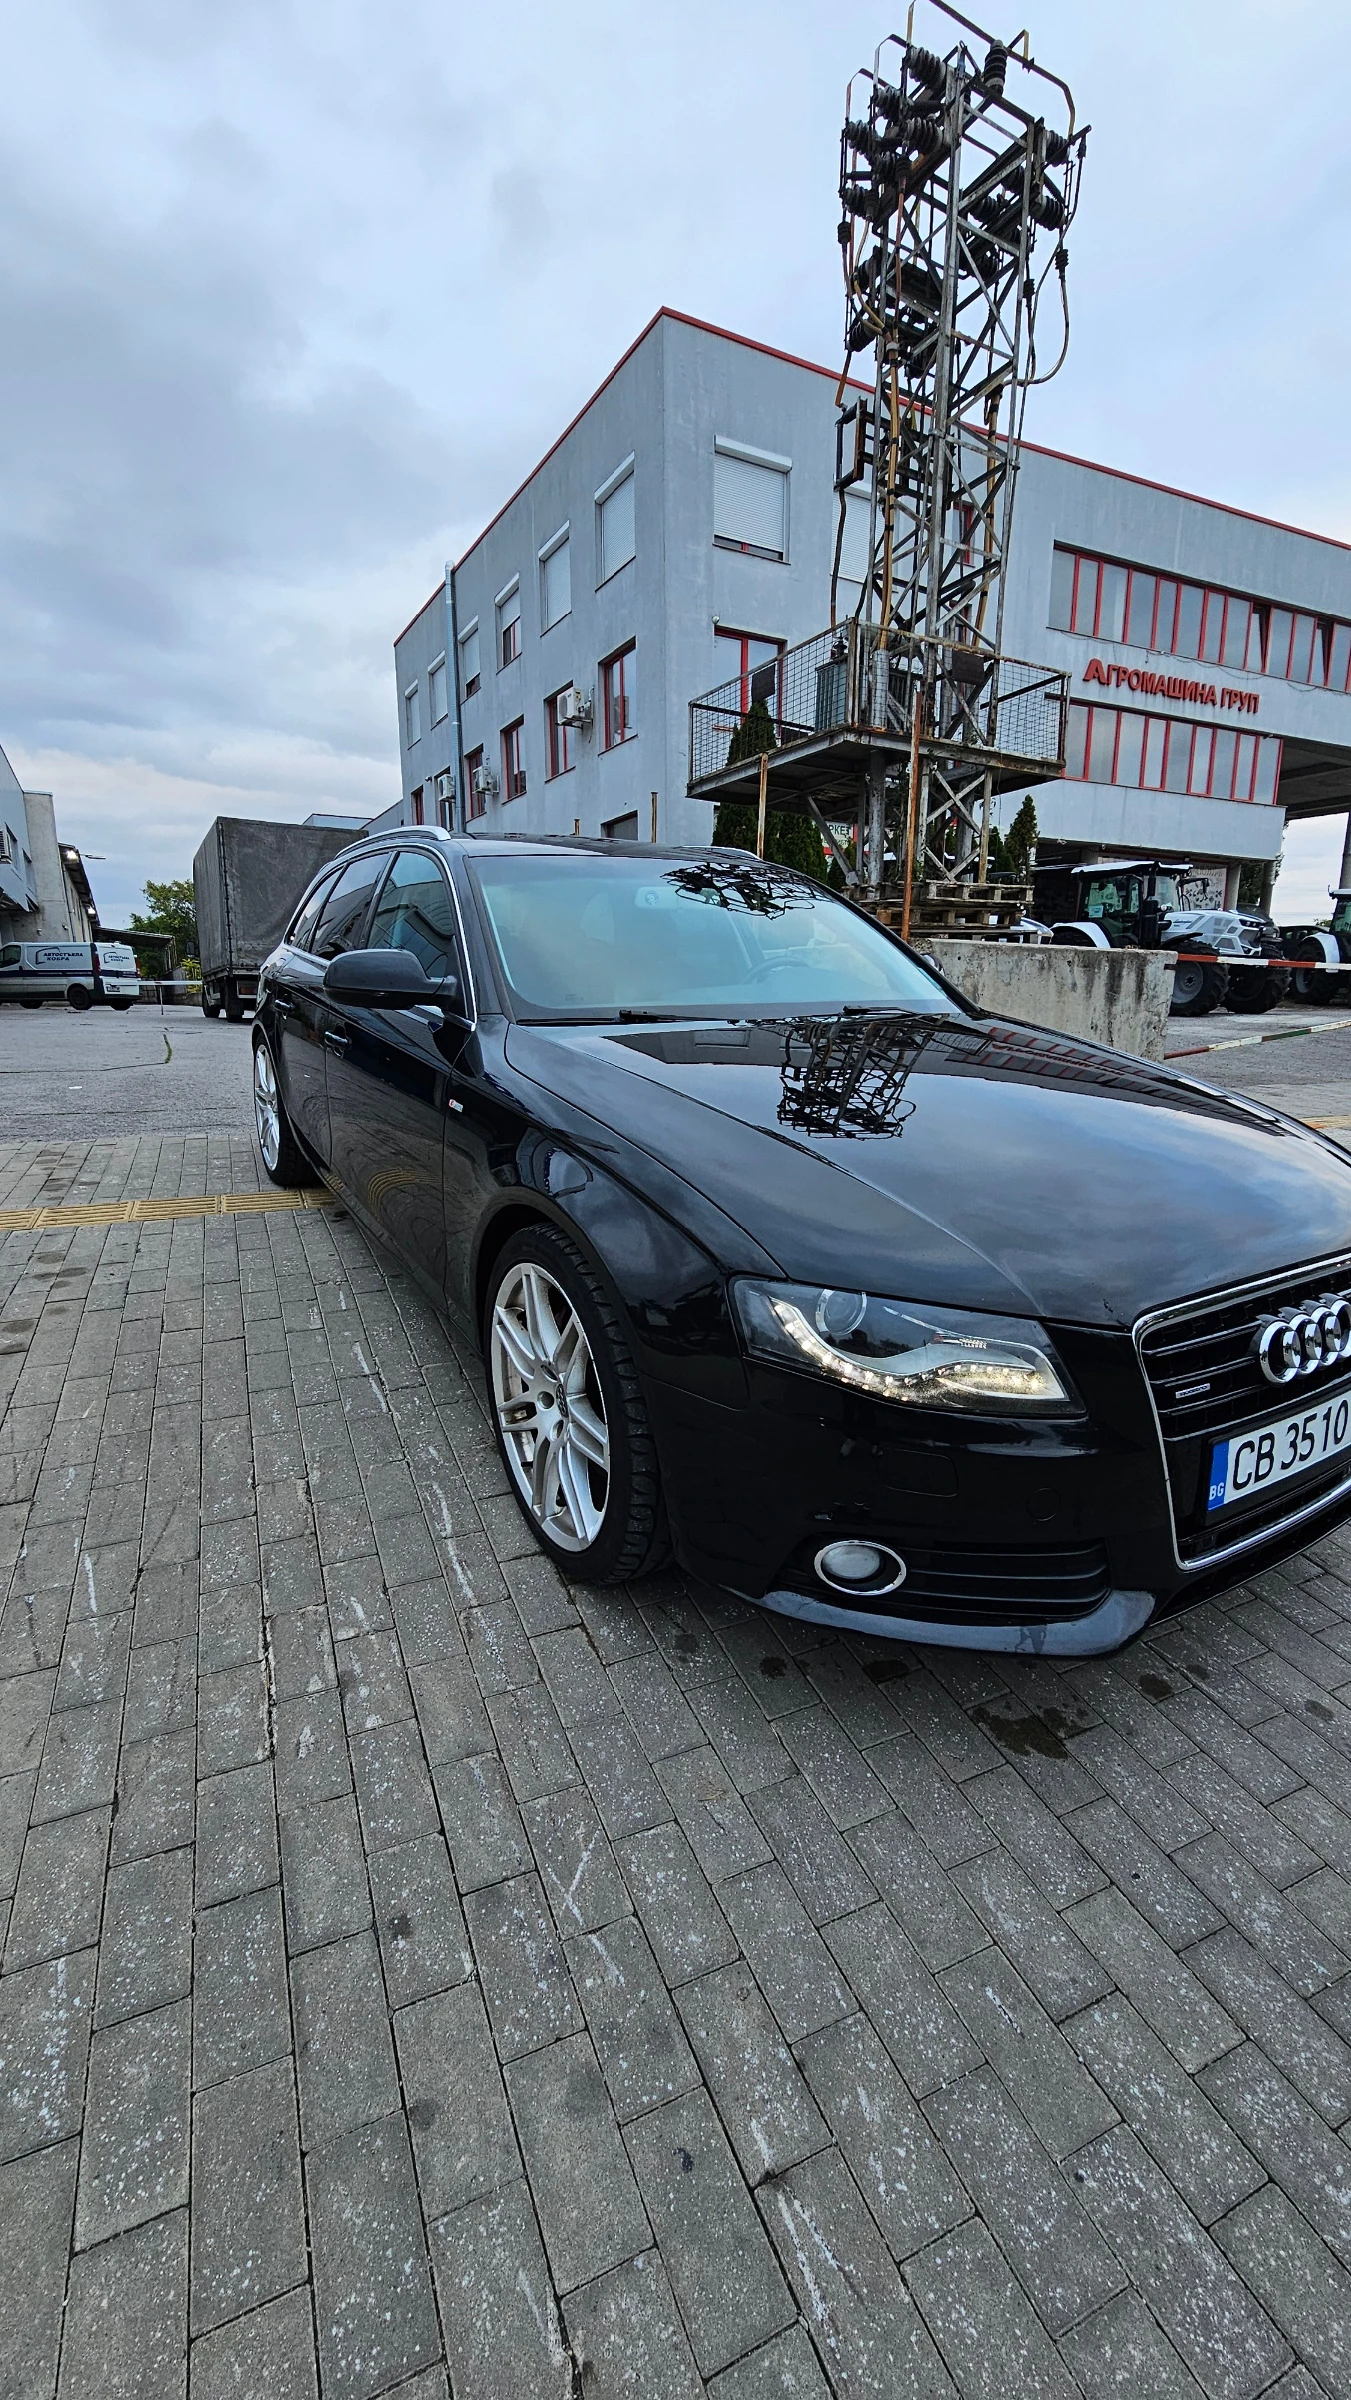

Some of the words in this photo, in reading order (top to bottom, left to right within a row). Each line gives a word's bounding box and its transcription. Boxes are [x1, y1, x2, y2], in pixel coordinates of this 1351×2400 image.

[1083, 658, 1217, 706] АГРОМАШИНА
[1220, 687, 1260, 714] ГРУП
[1232, 1432, 1275, 1491] CB
[1280, 1399, 1349, 1471] 3510
[1209, 1482, 1225, 1501] BG
